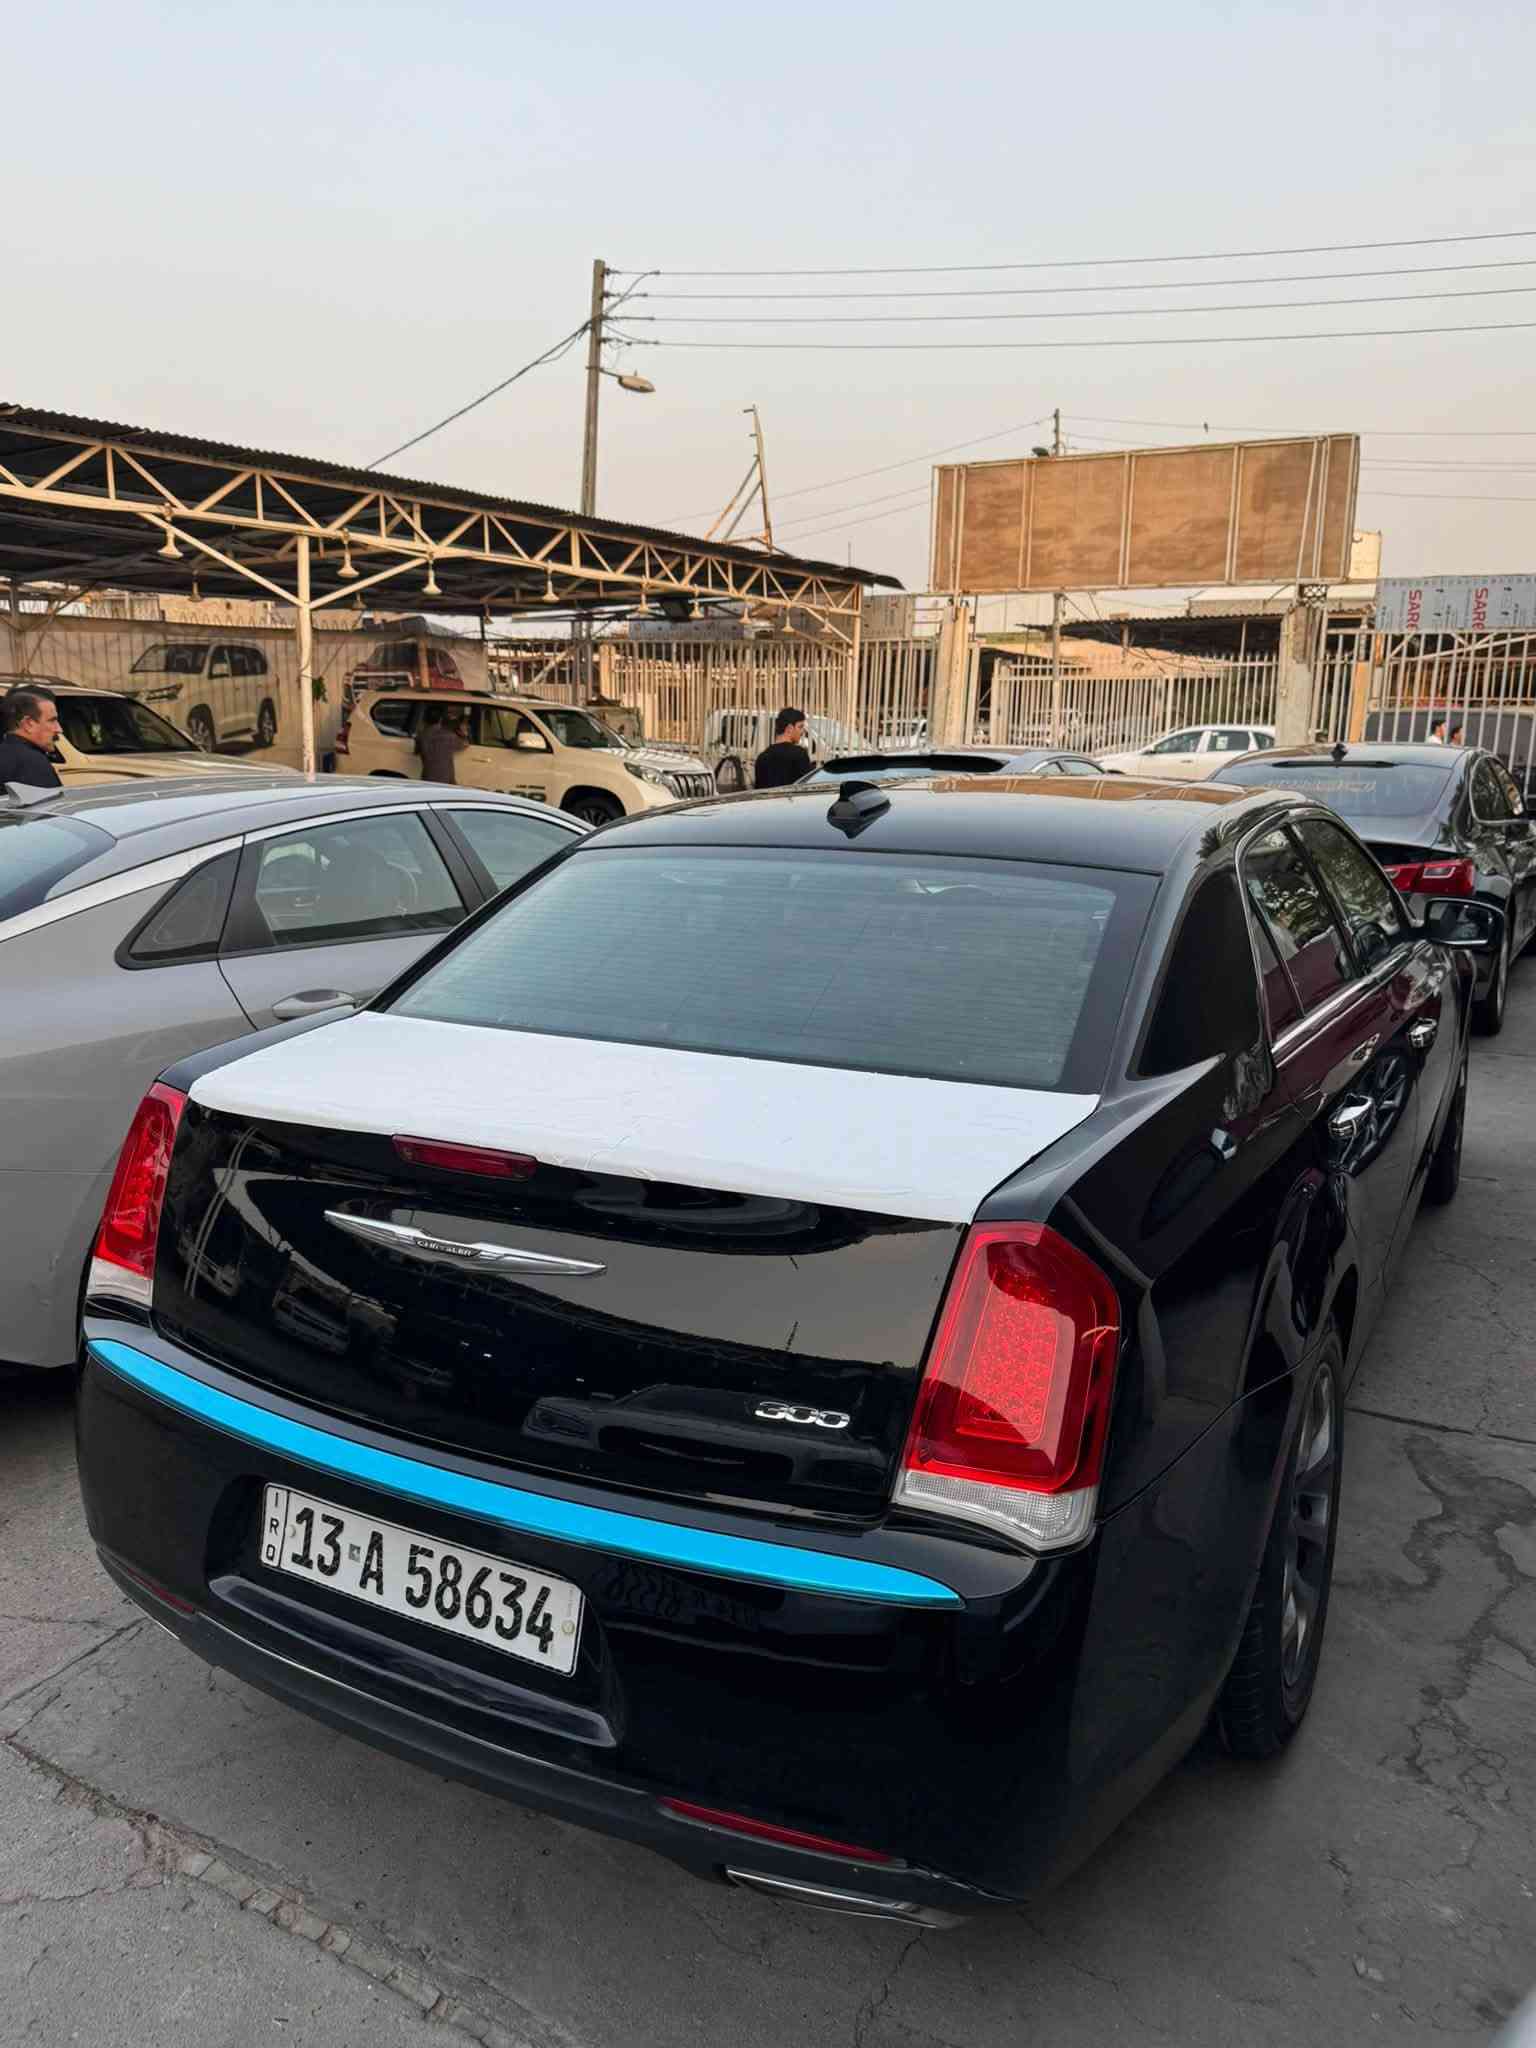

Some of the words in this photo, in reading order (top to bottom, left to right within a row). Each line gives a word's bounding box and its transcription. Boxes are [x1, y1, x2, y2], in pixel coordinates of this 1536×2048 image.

[755, 1401, 850, 1428] 300
[291, 1507, 344, 1576] 13
[359, 1531, 384, 1595] A
[405, 1543, 554, 1654] 58634
